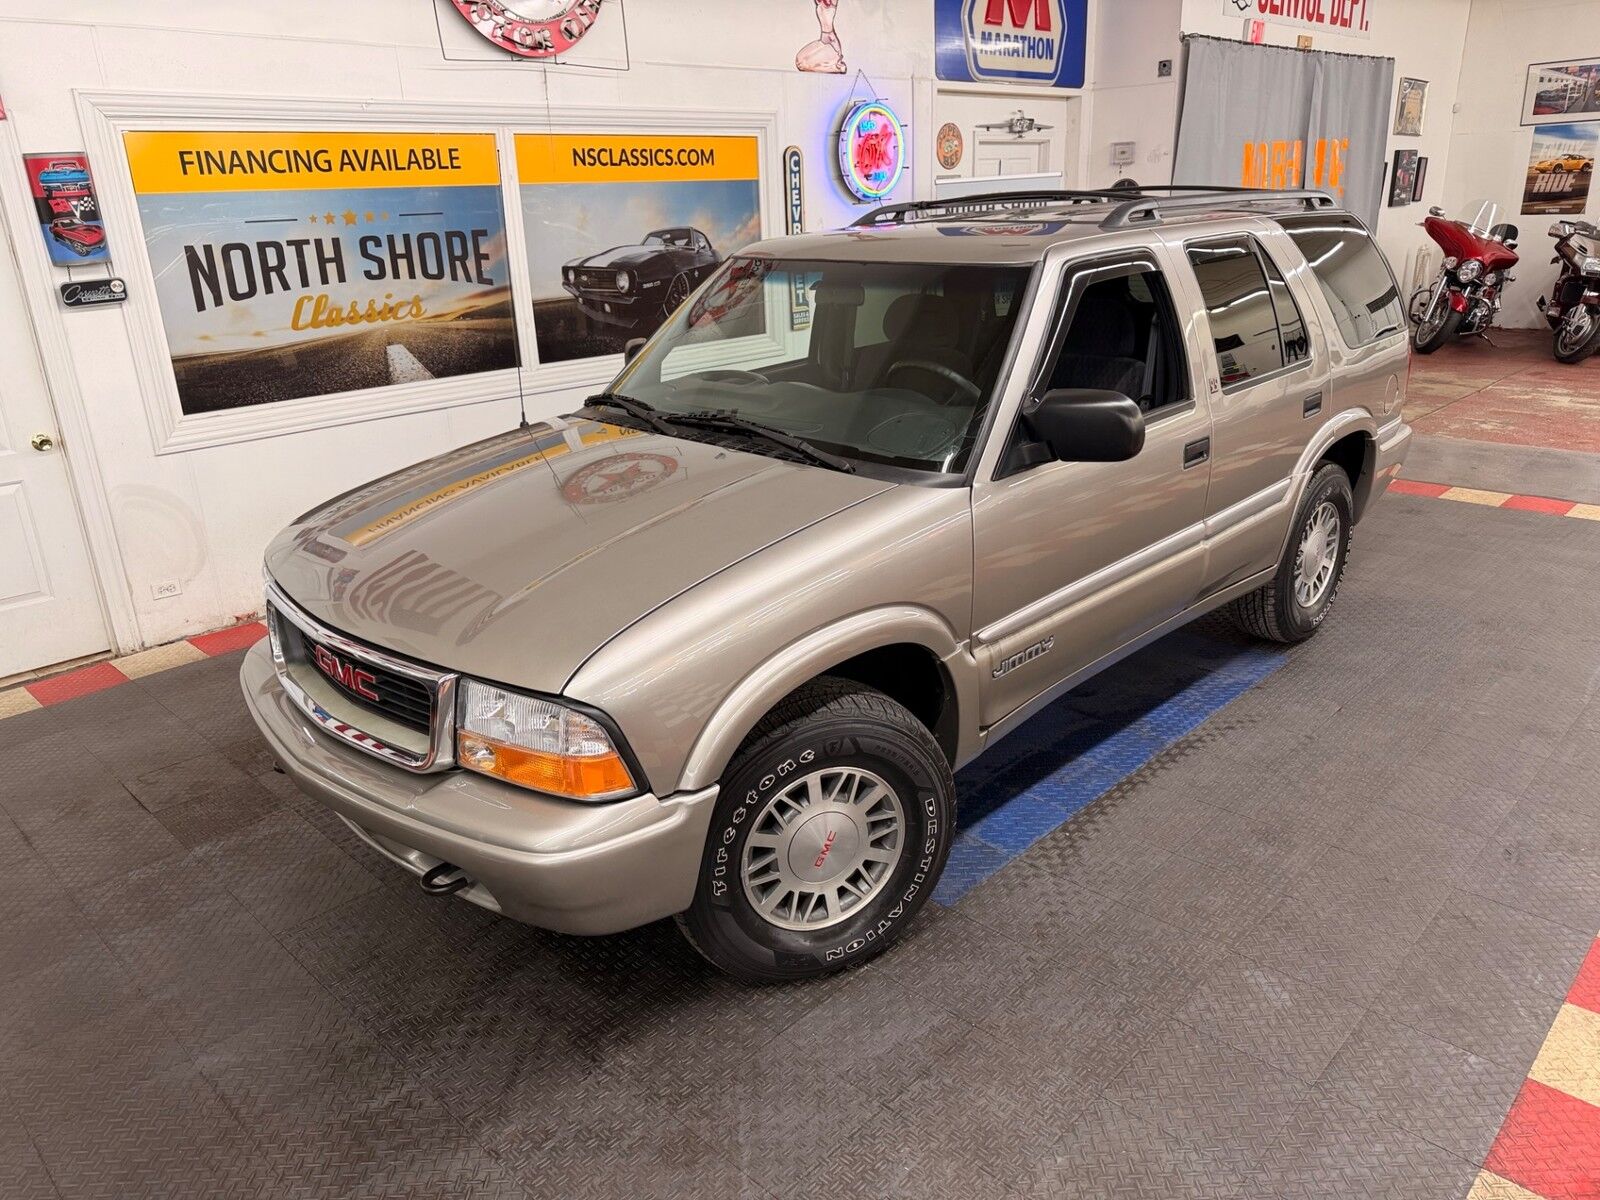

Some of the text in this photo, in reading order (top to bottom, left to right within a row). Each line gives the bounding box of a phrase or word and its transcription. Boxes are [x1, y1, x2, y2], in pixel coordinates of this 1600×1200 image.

[980, 31, 1054, 60] MARATHON
[178, 147, 462, 175] FINANCING AVAILABLE
[572, 147, 714, 167] NSCLASSICS.COM
[1533, 173, 1576, 193] RIDE
[184, 229, 494, 313] NORTH SHORE
[291, 294, 427, 331] Classics
[315, 644, 380, 702] GMC
[814, 830, 838, 870] GMC
[825, 797, 939, 962] DESTINATION
